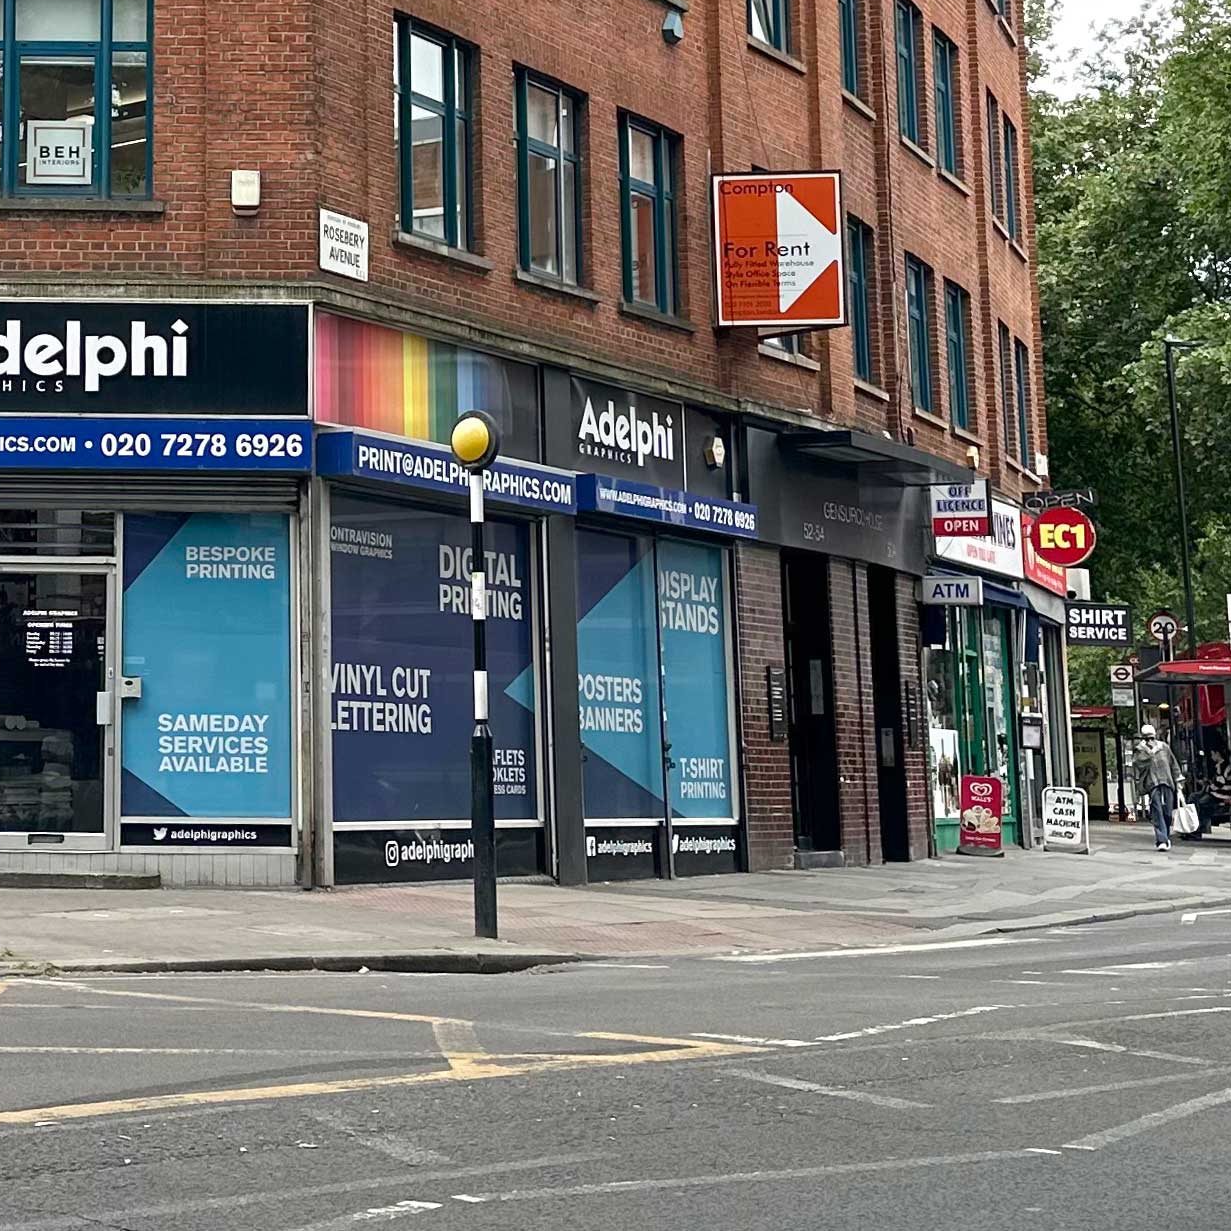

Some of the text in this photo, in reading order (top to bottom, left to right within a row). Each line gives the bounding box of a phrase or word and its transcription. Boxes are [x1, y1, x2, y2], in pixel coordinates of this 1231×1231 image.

[39, 146, 80, 158] BEH
[720, 182, 793, 197] Compton
[323, 223, 366, 249] ROSEBERY
[329, 246, 361, 269] AVENUE
[724, 241, 810, 258] For Rent
[578, 396, 675, 467] Adelphi
[101, 434, 151, 456] 020
[161, 434, 227, 456] 7278
[235, 434, 303, 456] 6926
[579, 443, 632, 465] GRAPHICS
[358, 445, 572, 506] PRINT@ADELPHRAPHICS.COM
[948, 485, 972, 498] OFF
[1025, 487, 1095, 512] OPEN
[599, 487, 756, 531] WWW.ADELPHIGRAPHICS.COM 020 7278 6926
[936, 500, 986, 512] LICENCE
[803, 522, 825, 541] 52-54
[944, 520, 979, 532] OPEN
[330, 526, 392, 548] ONTRAVISION
[1039, 523, 1086, 549] EC1
[186, 547, 276, 562] BESPOKE
[360, 546, 393, 560] GRAPHICS
[186, 564, 275, 580] PRINTING
[439, 544, 522, 588] DIGTAL
[932, 583, 970, 599] ATM
[439, 583, 523, 620] PRITING
[1069, 608, 1126, 626] SHIRT
[1069, 626, 1127, 641] SERVICE
[391, 667, 431, 699] CUT
[158, 713, 269, 733] SAMEDAY
[158, 735, 268, 755] SERVICES
[158, 756, 268, 773] AVAILABLE
[680, 758, 724, 779] T-SHIRT
[507, 785, 527, 795] CARDS
[680, 781, 726, 799] PRINTING
[1055, 796, 1074, 805] ATM
[1053, 807, 1076, 817] CASH
[171, 830, 257, 841] adelphigraphics
[679, 836, 736, 853] adelphigraphics
[597, 841, 653, 855] adelphigraphics
